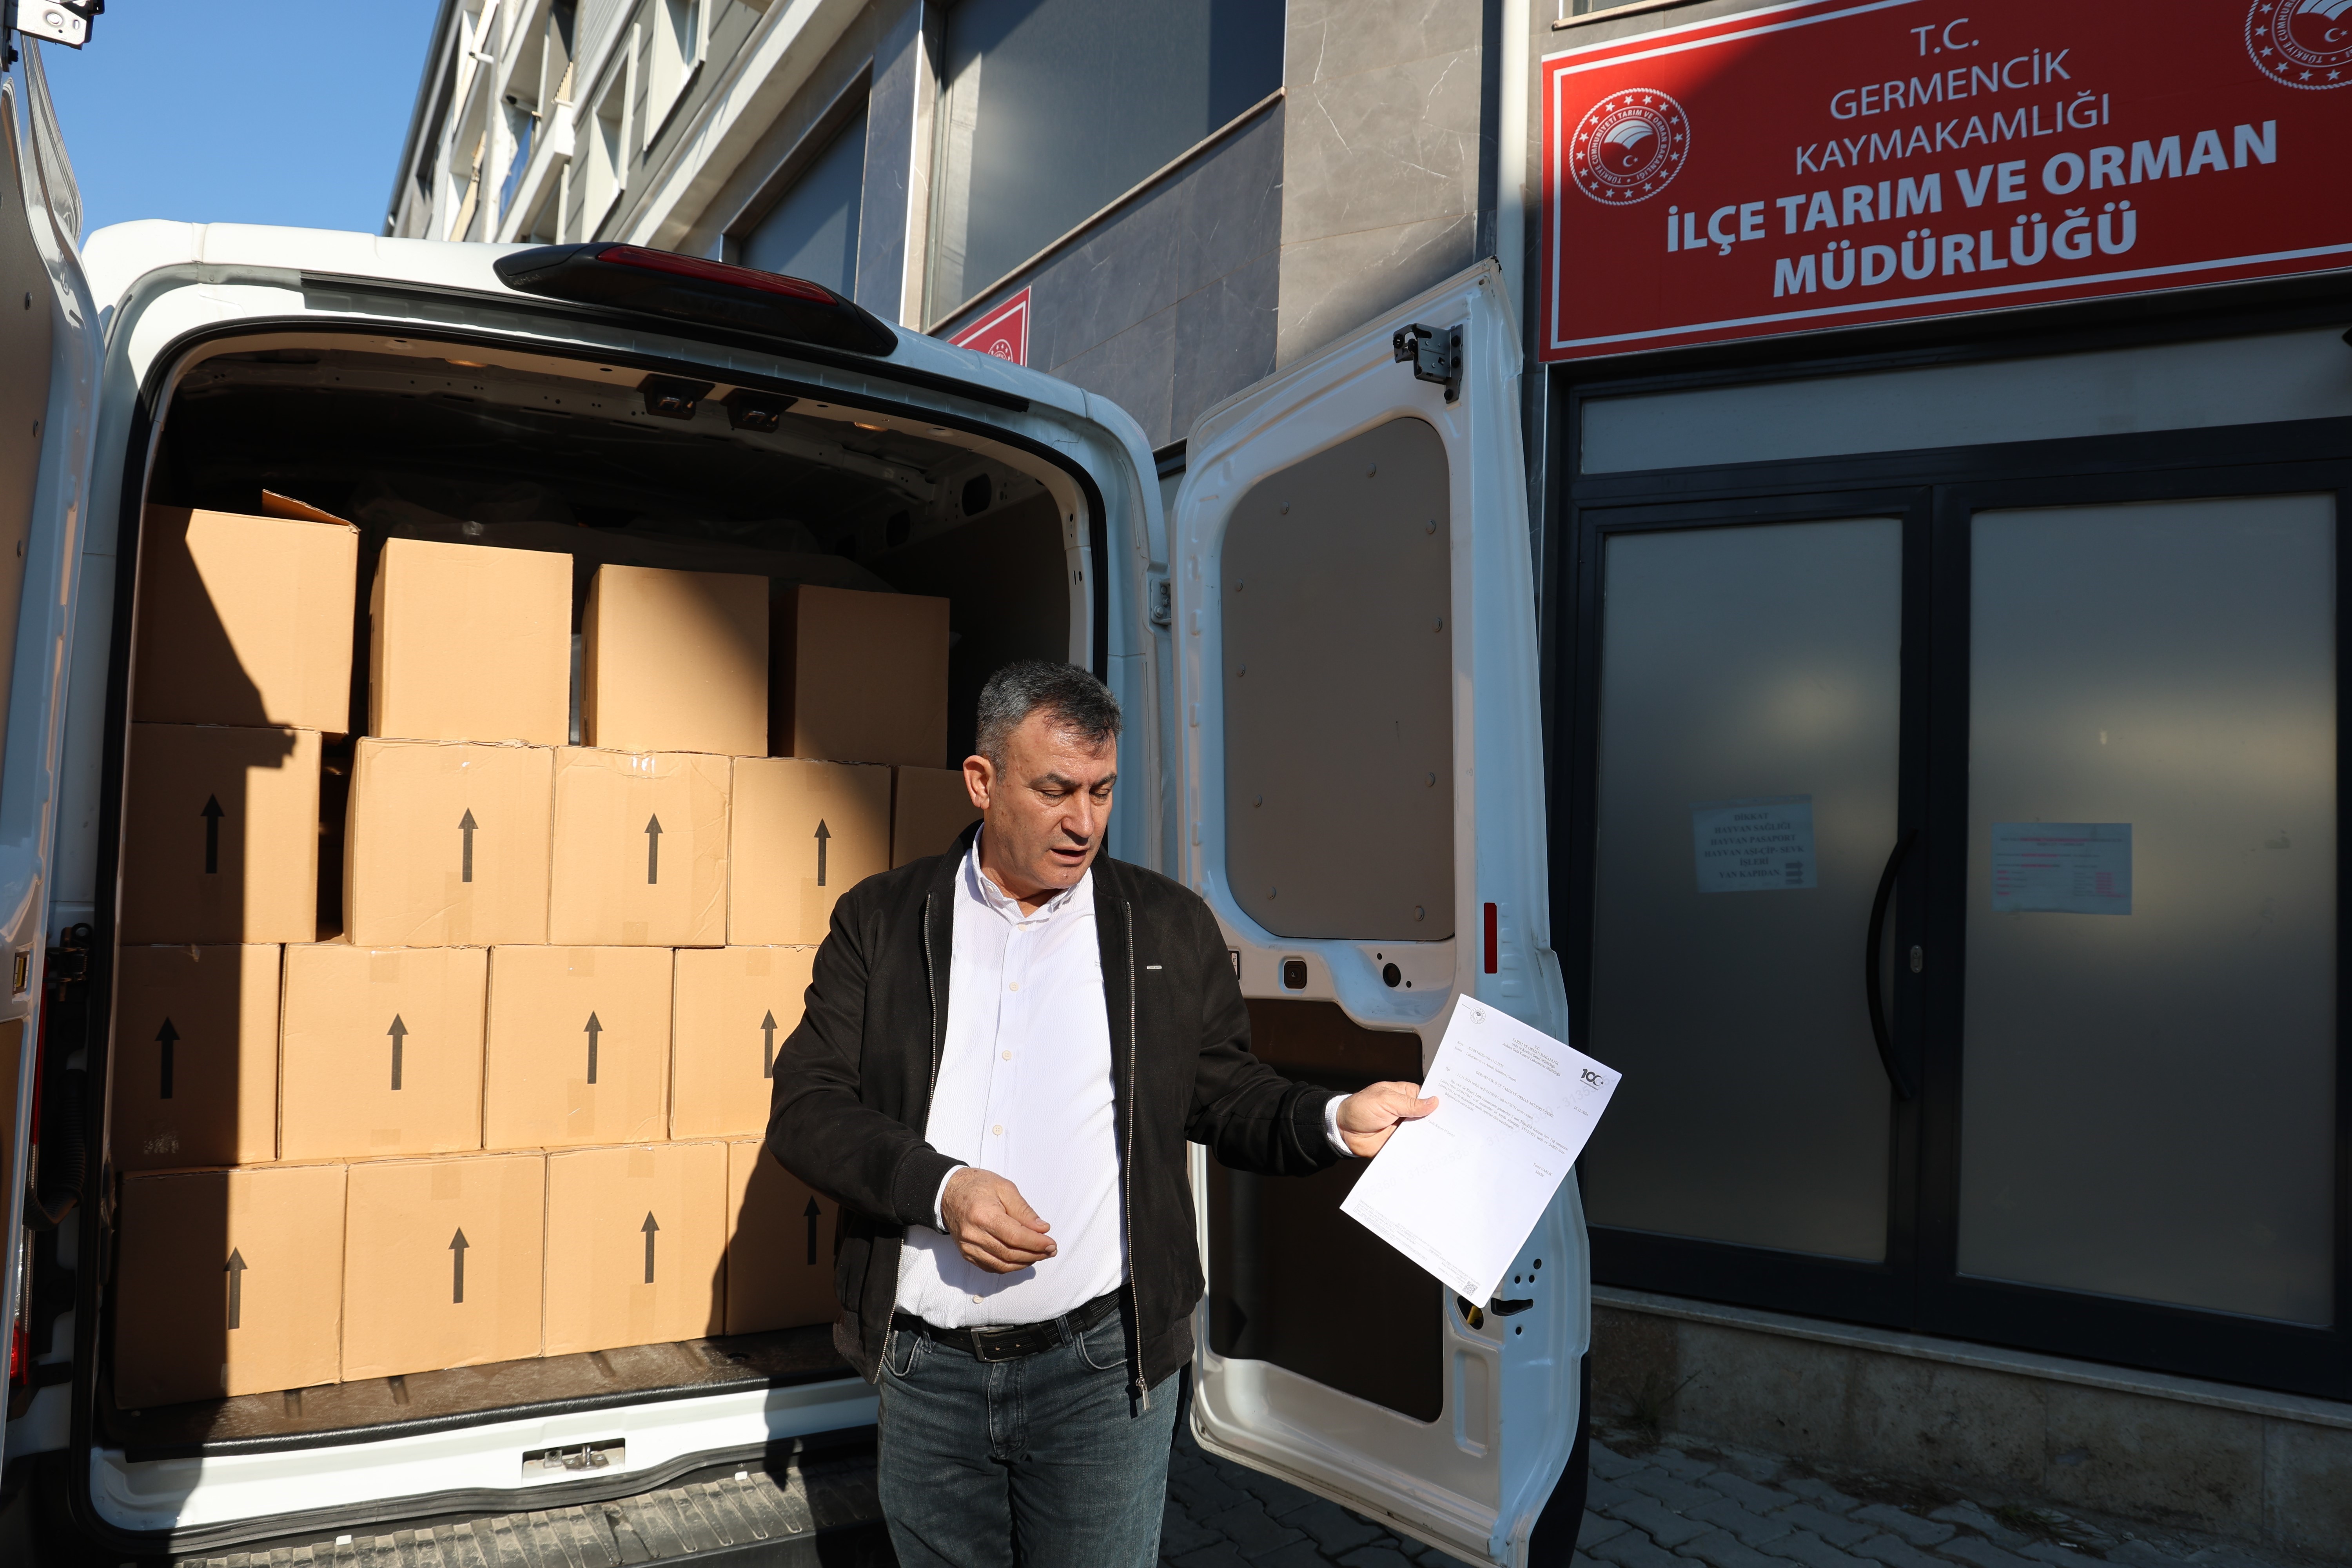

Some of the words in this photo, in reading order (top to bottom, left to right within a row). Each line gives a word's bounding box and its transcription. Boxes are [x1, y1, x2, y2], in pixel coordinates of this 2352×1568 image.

[1911, 18, 1979, 56] T.C.
[2282, 41, 2323, 63] TÜRKİYE
[1831, 49, 2070, 119] GERMENCİK
[1617, 109, 1642, 119] TARIM
[1589, 115, 1616, 165] CUMHURİYETİ
[1653, 117, 1668, 142] ORMAN
[1797, 90, 2108, 174] KAYMAKAMLIĞI
[1636, 143, 1668, 181] BAKANLIĞI
[1594, 163, 1622, 184] TÜRKİYE
[1668, 201, 1765, 255] İLÇE
[1777, 173, 1942, 234] TARIM
[1955, 160, 2026, 207] VE
[2043, 120, 2276, 194] ORMAN
[1774, 200, 2136, 297] MÜDÜRLÜĞÜ
[1734, 812, 1769, 821] DİKKAT
[1753, 822, 1791, 831] SAĞLIĞI
[1750, 835, 1796, 843] PASAPORT
[1704, 849, 1741, 857] HAYVAN
[1740, 857, 1769, 866] İŞLERİ
[1540, 1053, 1559, 1065] BAKANLIĞI
[1475, 1071, 1495, 1083] GERMENCİK
[1517, 1094, 1529, 1103] ORMAN
[1528, 1101, 1554, 1118] MÜDÜRLÜĞÜNE
[1573, 1106, 1588, 1116] 16.12.2024
